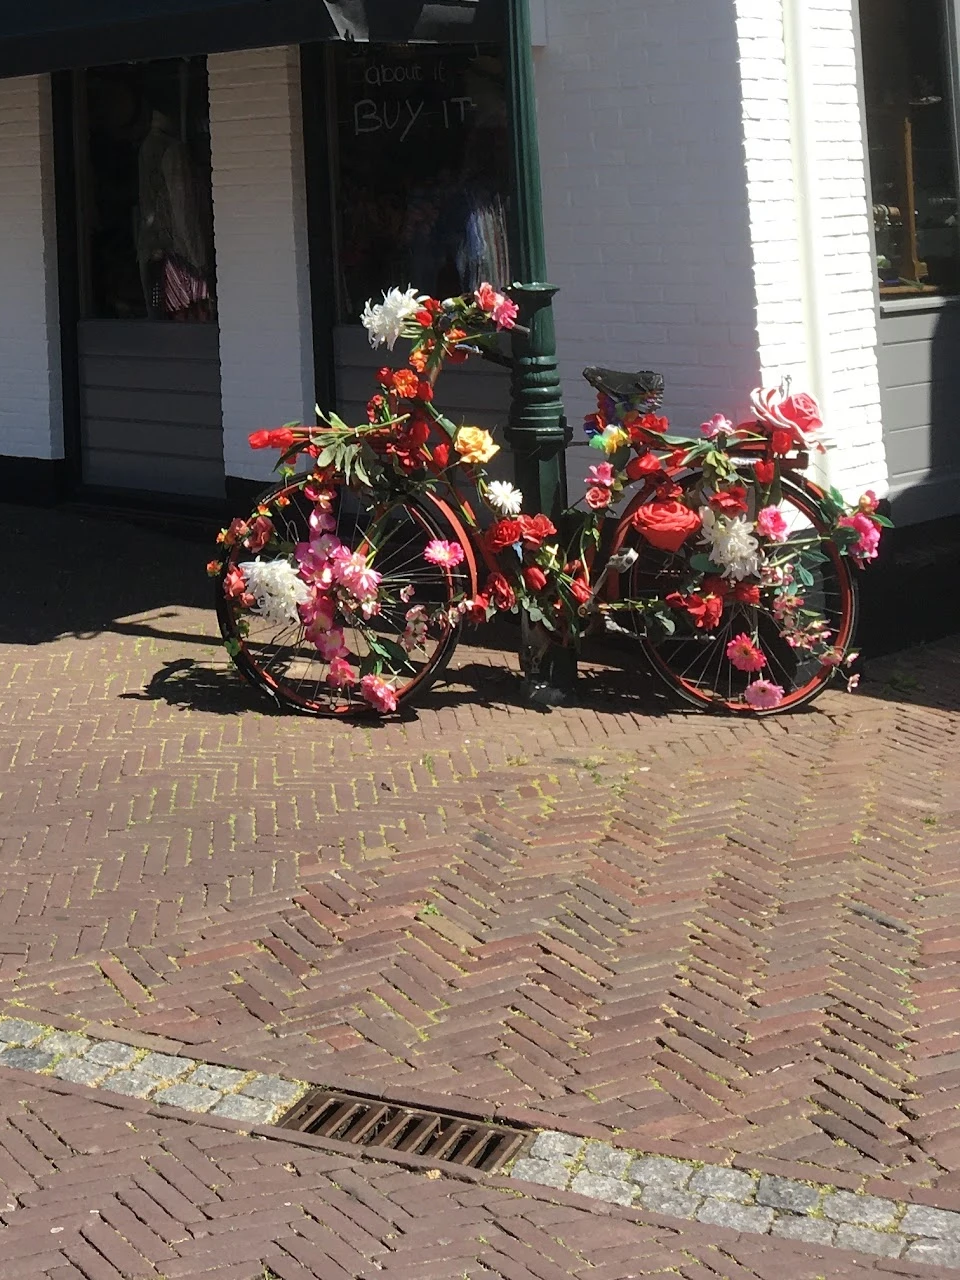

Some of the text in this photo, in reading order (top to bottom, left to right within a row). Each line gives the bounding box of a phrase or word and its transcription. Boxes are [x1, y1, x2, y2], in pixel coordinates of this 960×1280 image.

[364, 63, 423, 87] about
[353, 96, 473, 143] BUY IT
